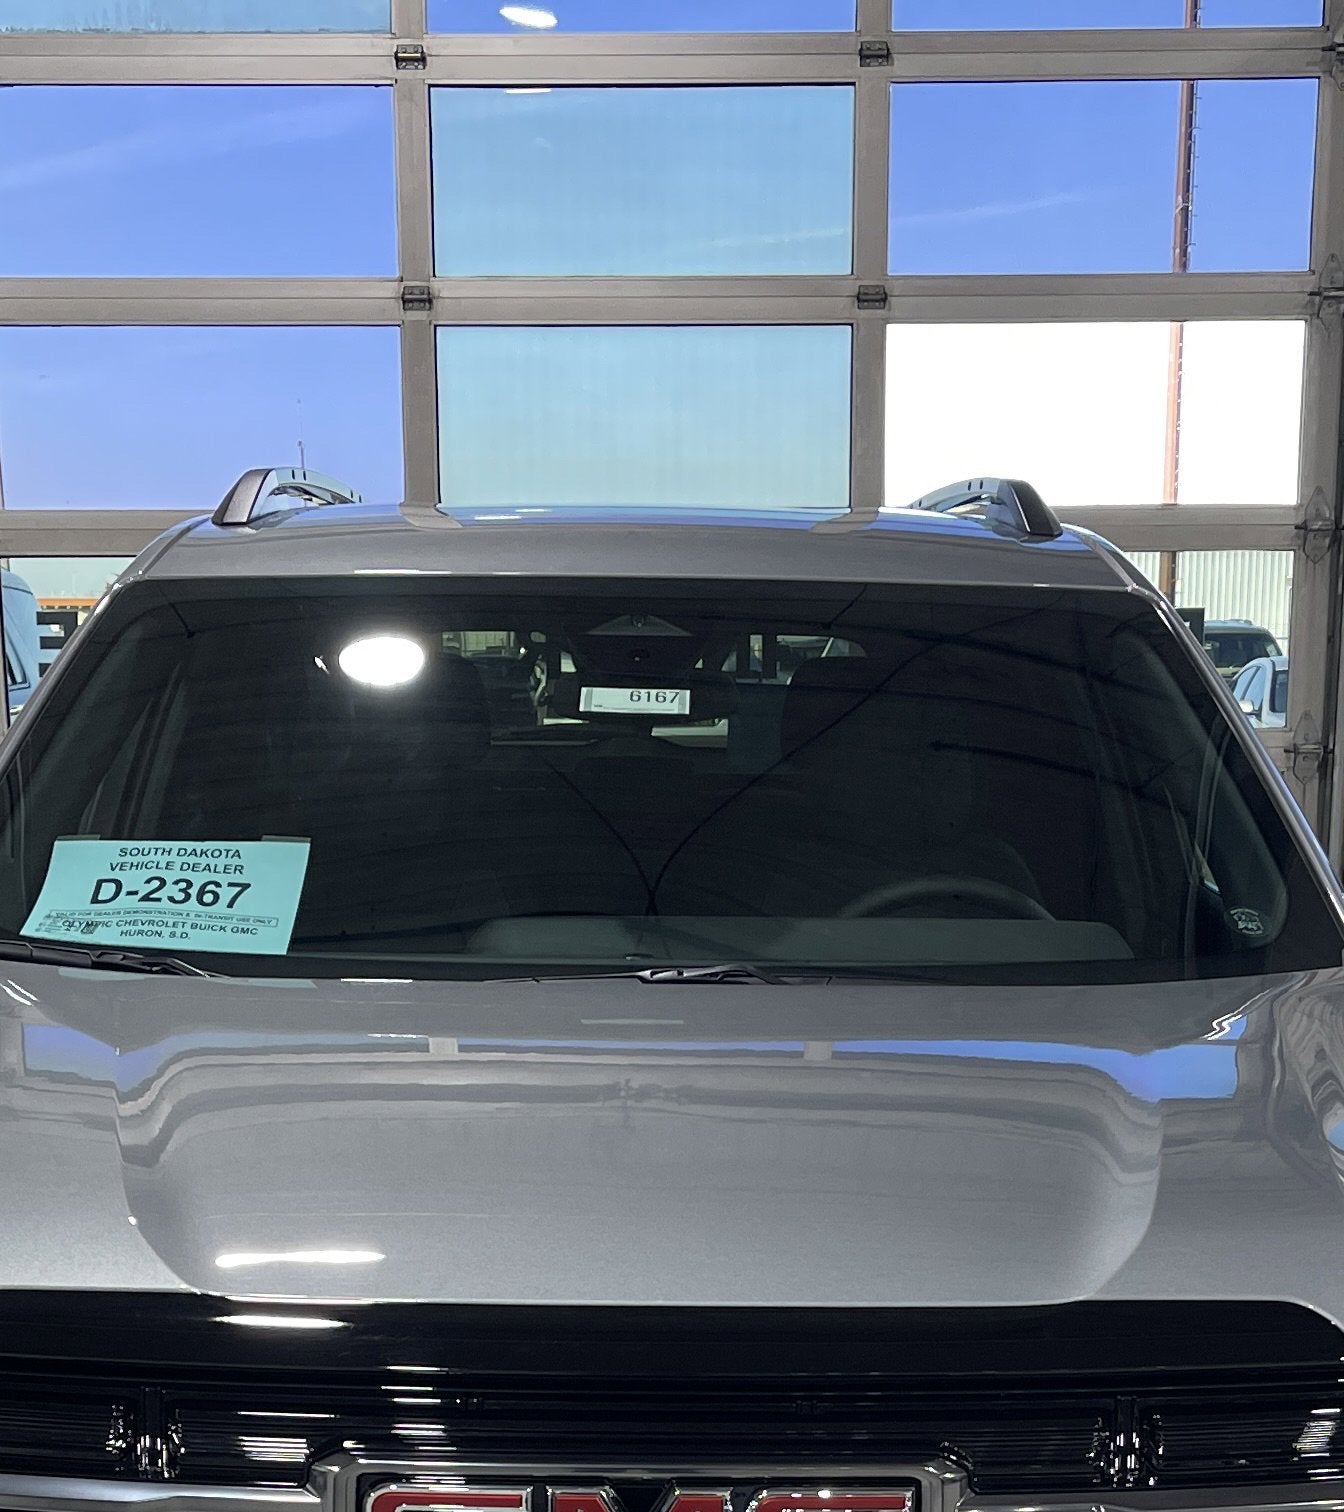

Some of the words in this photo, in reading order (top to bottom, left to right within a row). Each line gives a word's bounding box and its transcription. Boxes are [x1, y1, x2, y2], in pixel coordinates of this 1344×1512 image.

[629, 690, 680, 704] 6167
[118, 847, 173, 858] SOUTH
[176, 848, 242, 859] DAKOTA
[109, 860, 176, 872] VEHICLE
[179, 862, 245, 875] DEALER
[89, 875, 252, 909] D-2367
[116, 919, 188, 928] CHEVROLET
[190, 922, 228, 933] BUICK
[230, 926, 258, 935] GMC
[119, 929, 165, 939] HURON,
